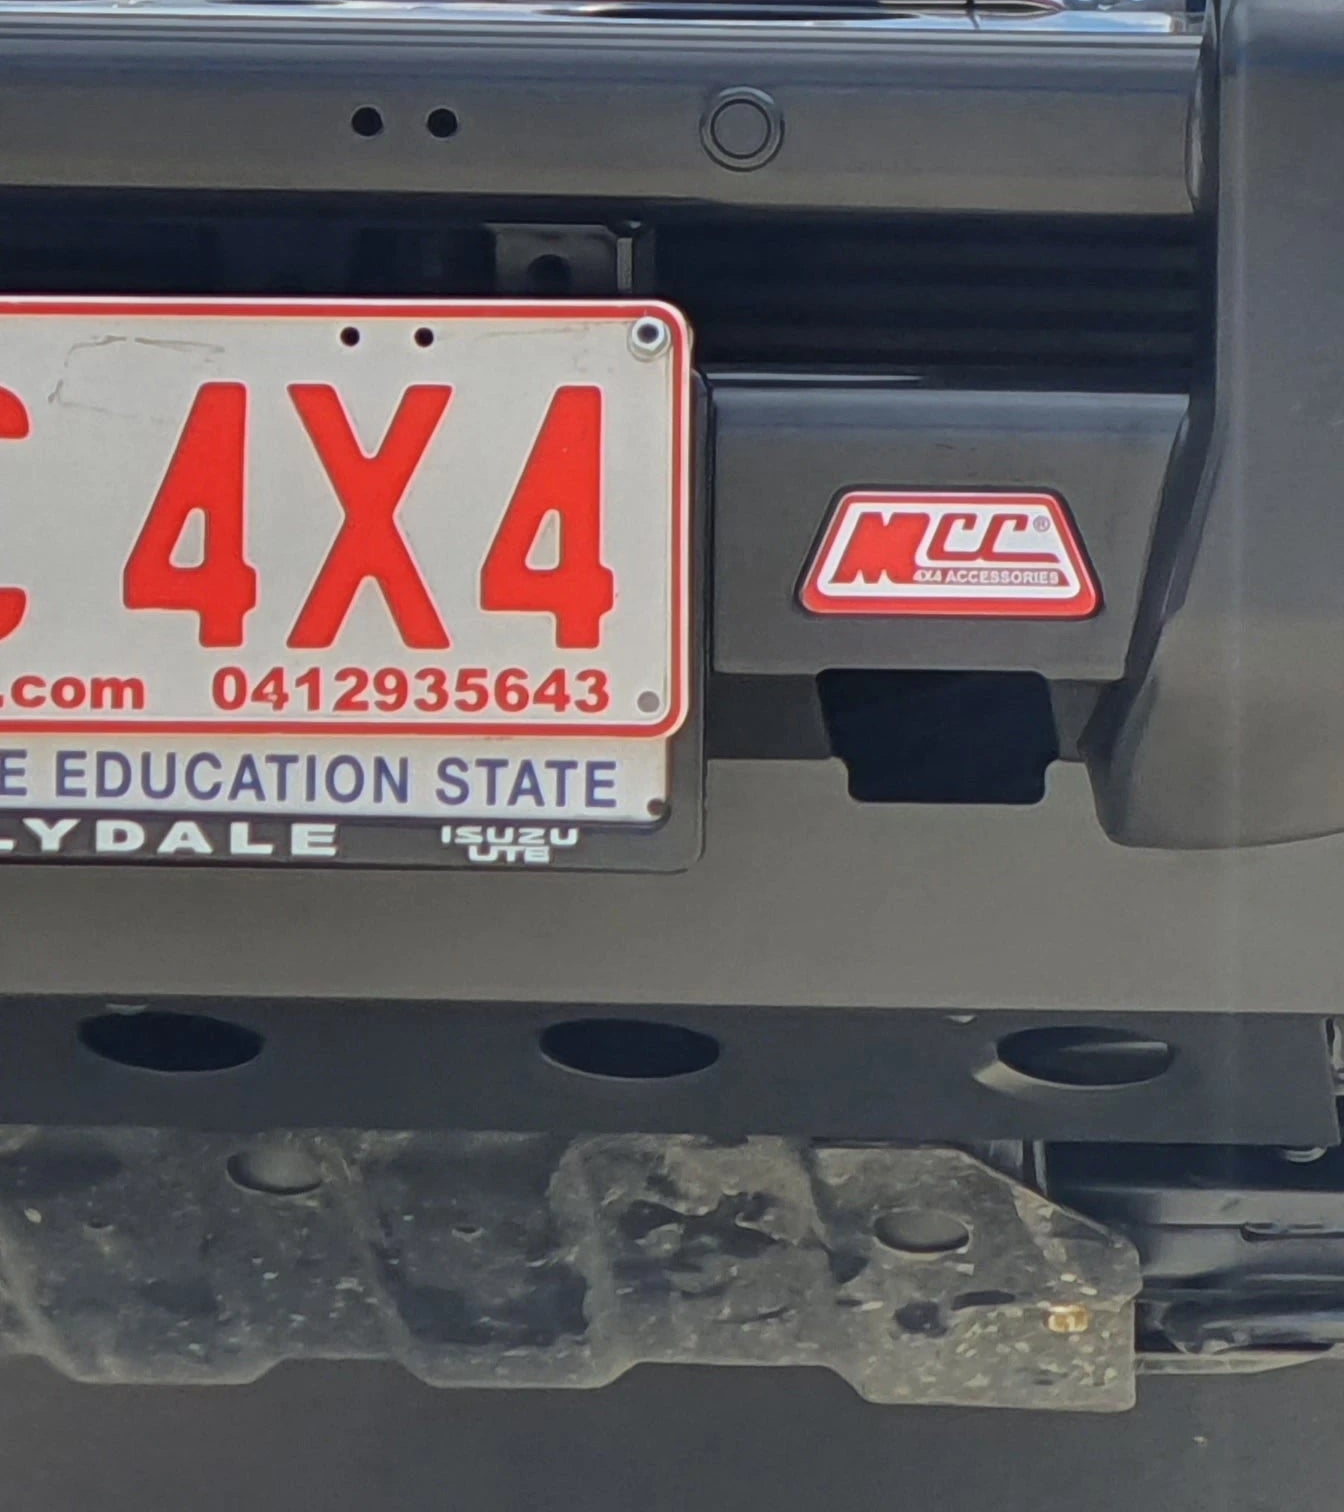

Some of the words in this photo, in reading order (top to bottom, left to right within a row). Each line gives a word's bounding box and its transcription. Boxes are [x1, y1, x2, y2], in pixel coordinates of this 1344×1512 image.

[122, 381, 615, 650] 4X4
[912, 570, 942, 583] 4X4
[945, 570, 1060, 585] ACCESSORIES
[210, 665, 611, 714] 0412935643
[55, 748, 411, 805] EDUCATION
[435, 756, 619, 810] STATE
[440, 825, 579, 846] ISUZU
[468, 845, 551, 864] UTE
